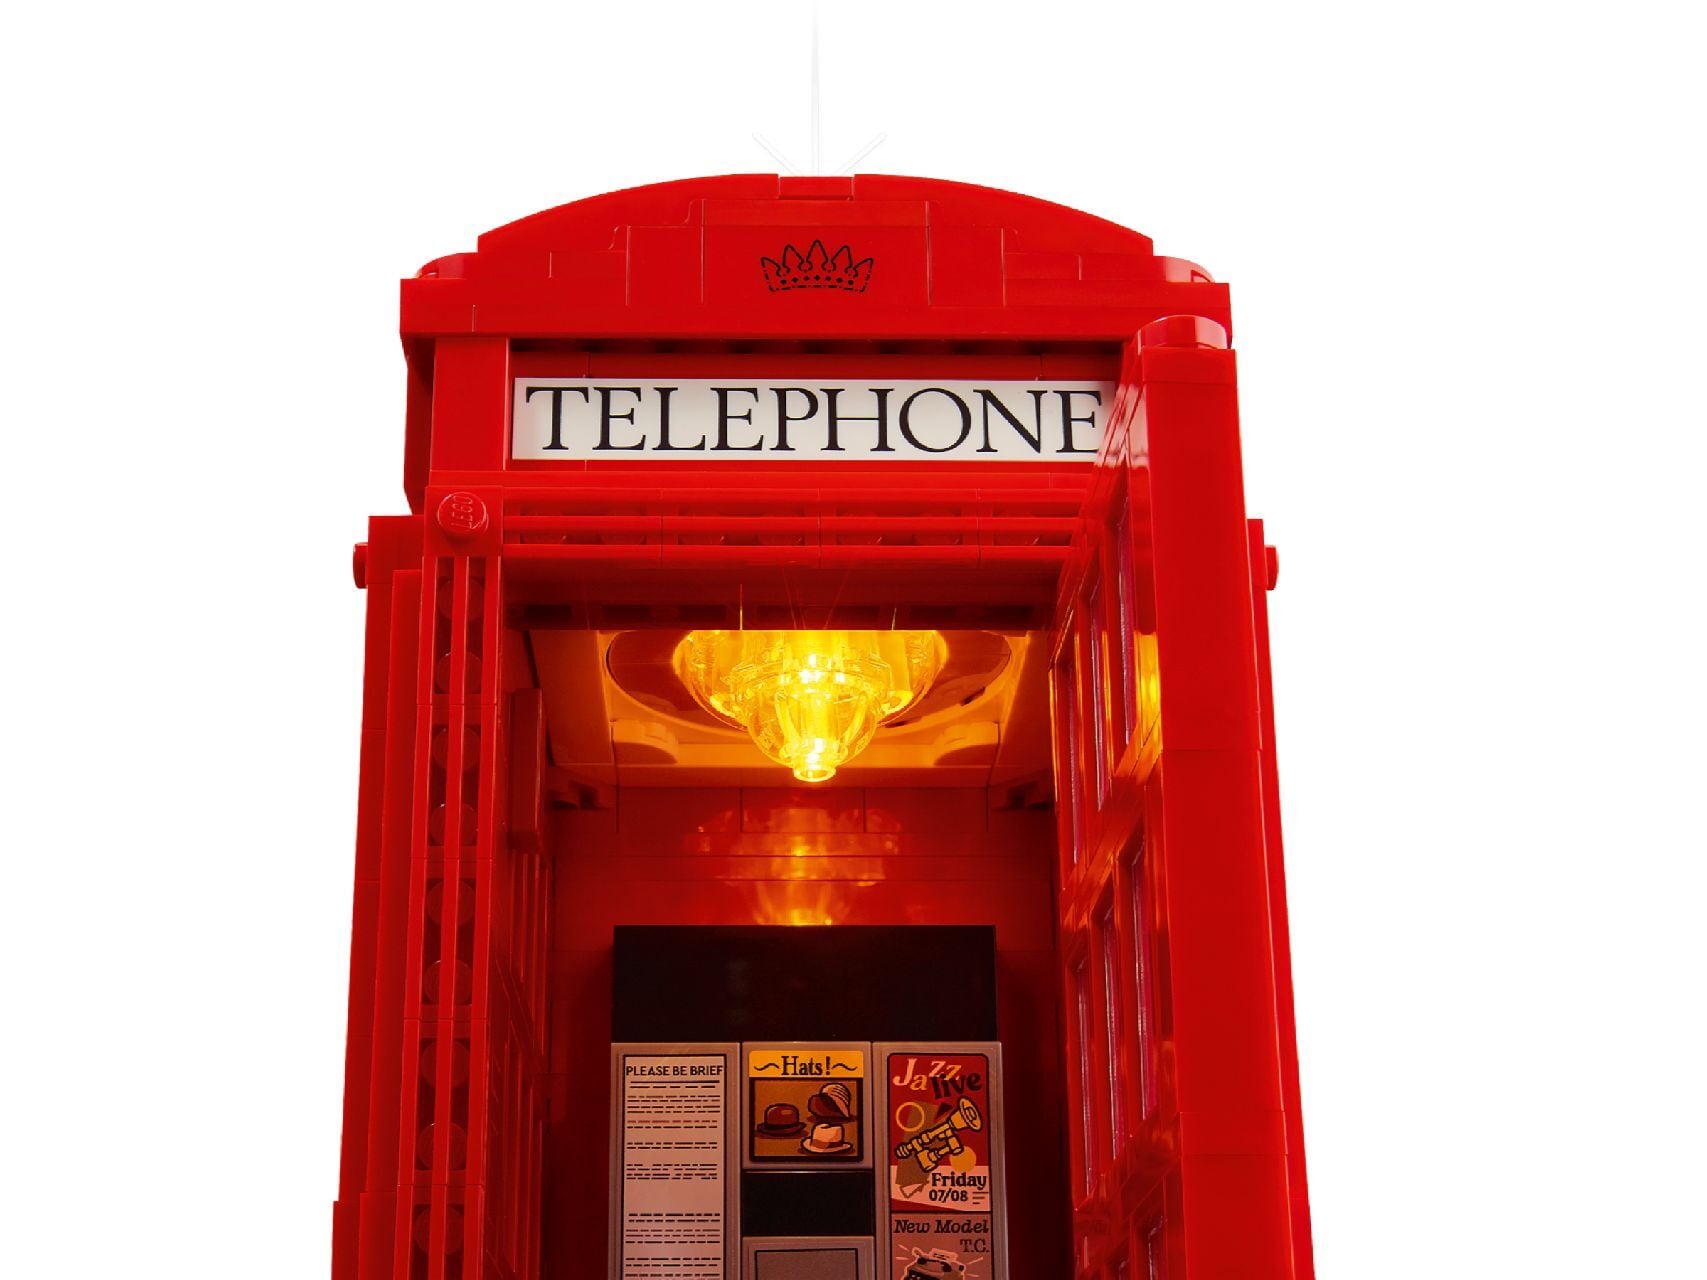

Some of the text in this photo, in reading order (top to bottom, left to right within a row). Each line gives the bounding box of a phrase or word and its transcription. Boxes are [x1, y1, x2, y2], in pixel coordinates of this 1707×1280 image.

[525, 386, 1103, 455] TELEPHONE
[626, 1065, 723, 1076] PLEASE BE BRIEF
[781, 1056, 831, 1076] Hats!
[930, 1073, 982, 1099] live
[931, 1171, 987, 1190] Friday
[929, 1188, 968, 1203] 07/08
[894, 1219, 989, 1234] New Model
[960, 1239, 990, 1253] T.C.
